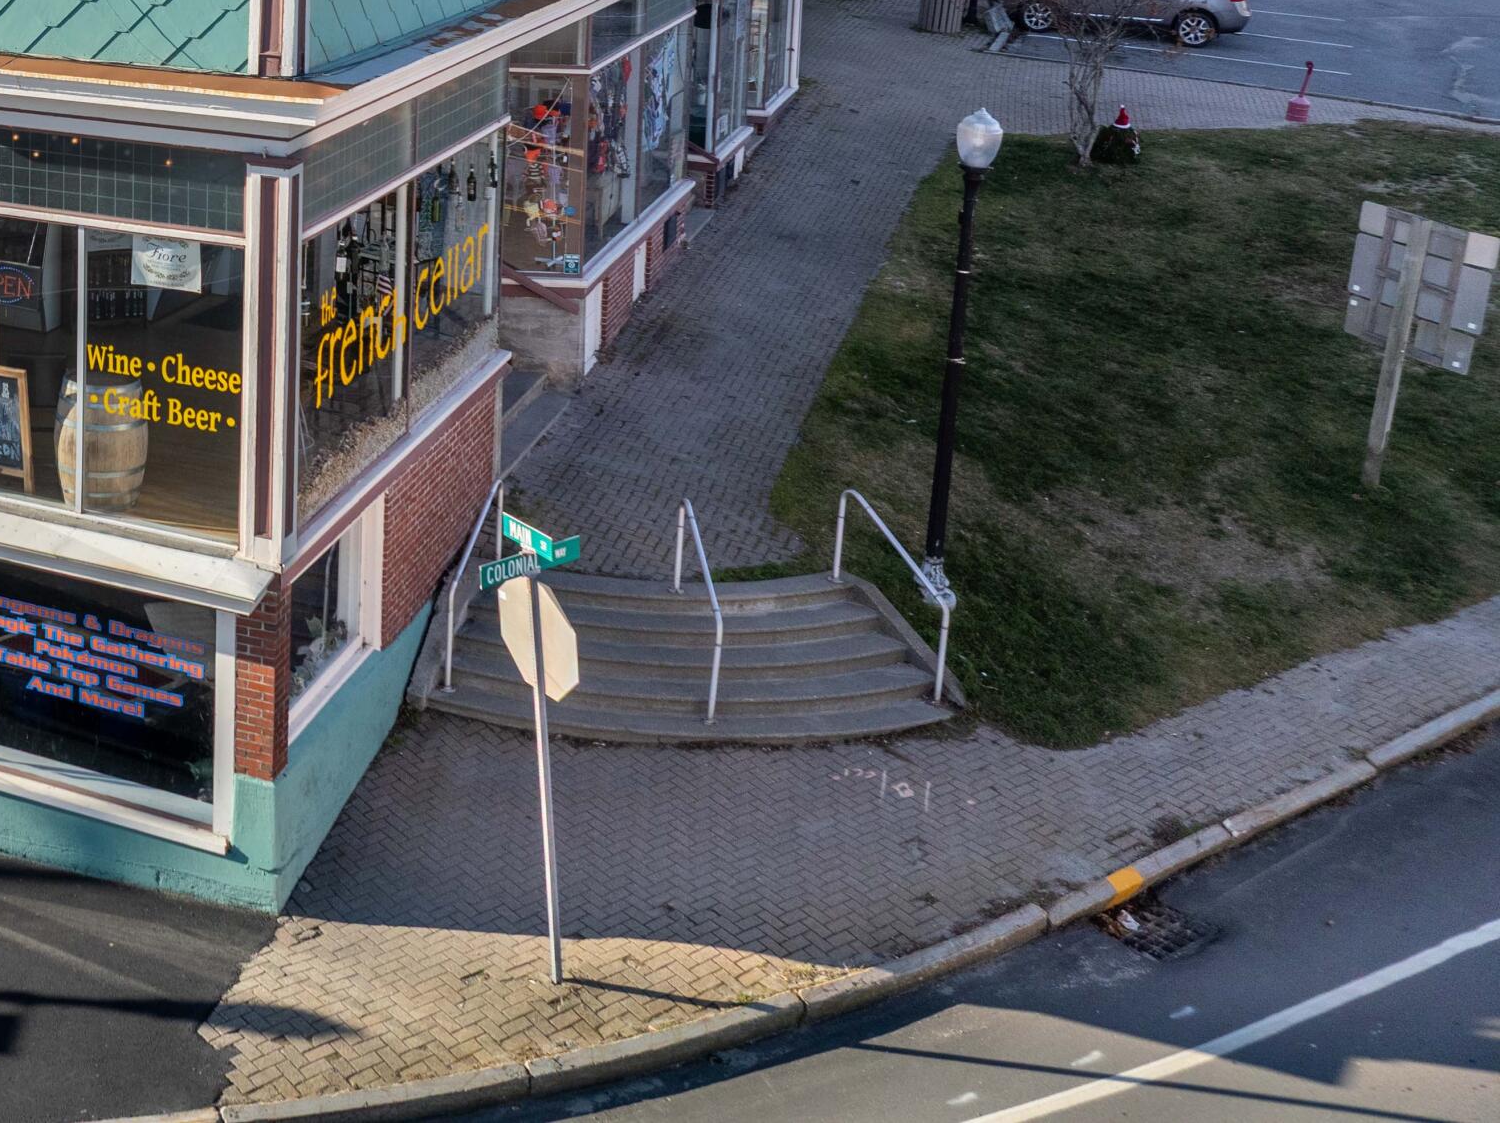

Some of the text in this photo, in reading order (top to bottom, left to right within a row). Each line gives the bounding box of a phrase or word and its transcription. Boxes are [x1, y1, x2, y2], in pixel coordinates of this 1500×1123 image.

[146, 242, 187, 263] Fiore
[314, 223, 489, 410] french cellar
[321, 286, 337, 327] the
[87, 344, 242, 394] Wine Cheese
[103, 387, 221, 432] Craft Beer
[509, 519, 532, 549] MAIN
[487, 555, 541, 584] COLONIAL
[42, 622, 85, 648] The
[90, 635, 204, 679] Gathering
[83, 613, 102, 632] &
[108, 619, 204, 655] Dragons
[33, 637, 138, 678] Pokémon
[26, 676, 145, 719] And More!
[57, 662, 100, 687] Top
[106, 676, 184, 707] Games
